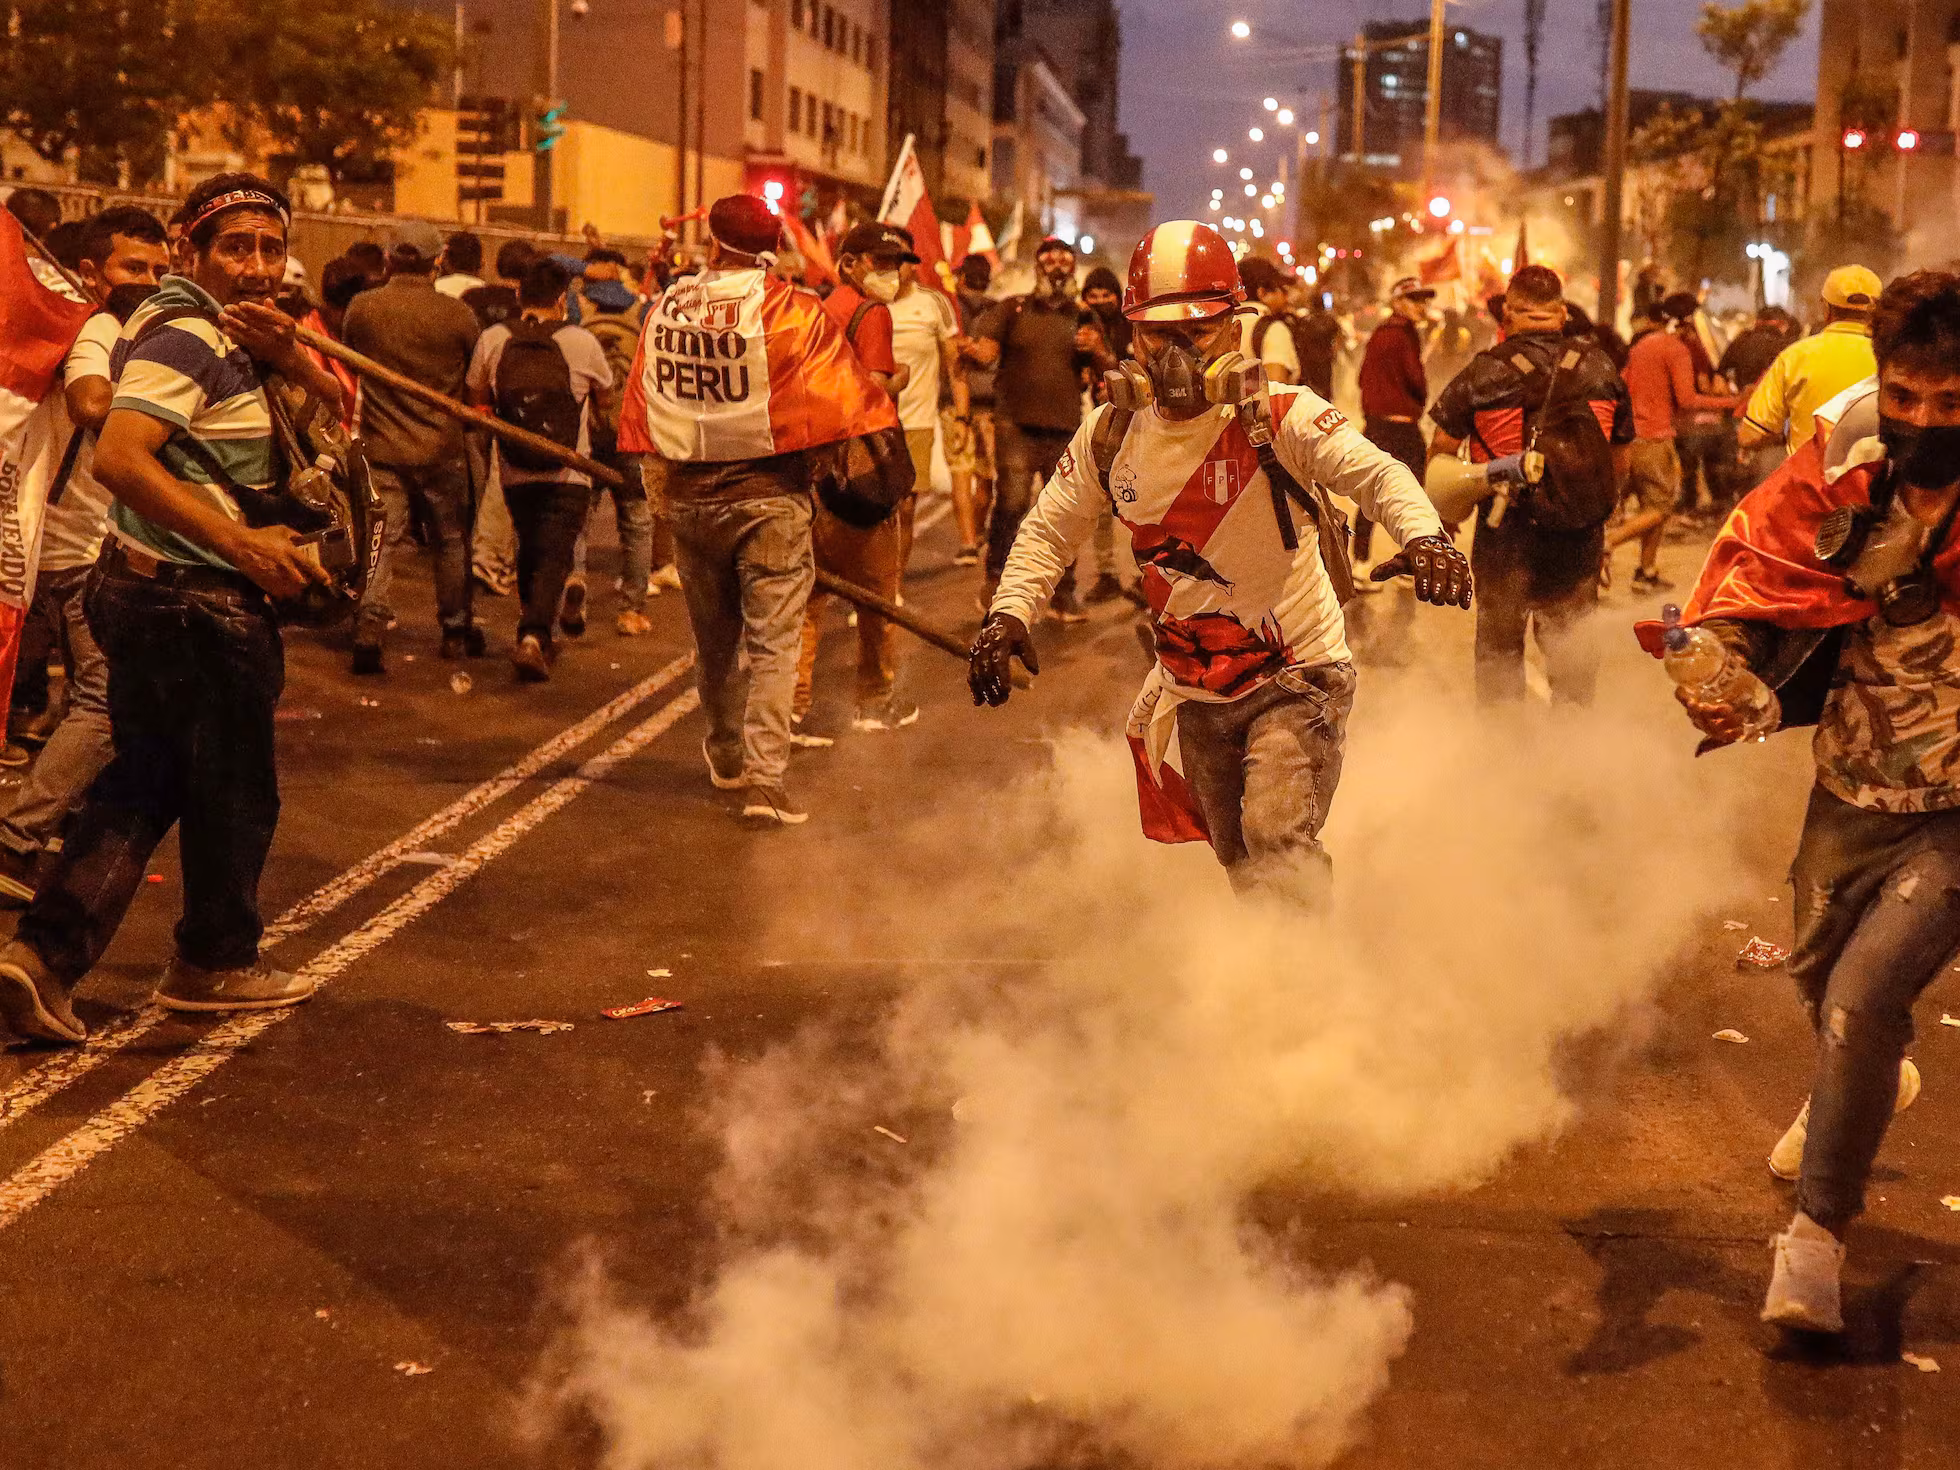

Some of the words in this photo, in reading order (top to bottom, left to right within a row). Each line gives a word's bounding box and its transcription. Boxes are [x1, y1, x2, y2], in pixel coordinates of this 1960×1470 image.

[655, 324, 747, 359] amo
[656, 356, 750, 402] PERU
[1169, 387, 1187, 397] 3M
